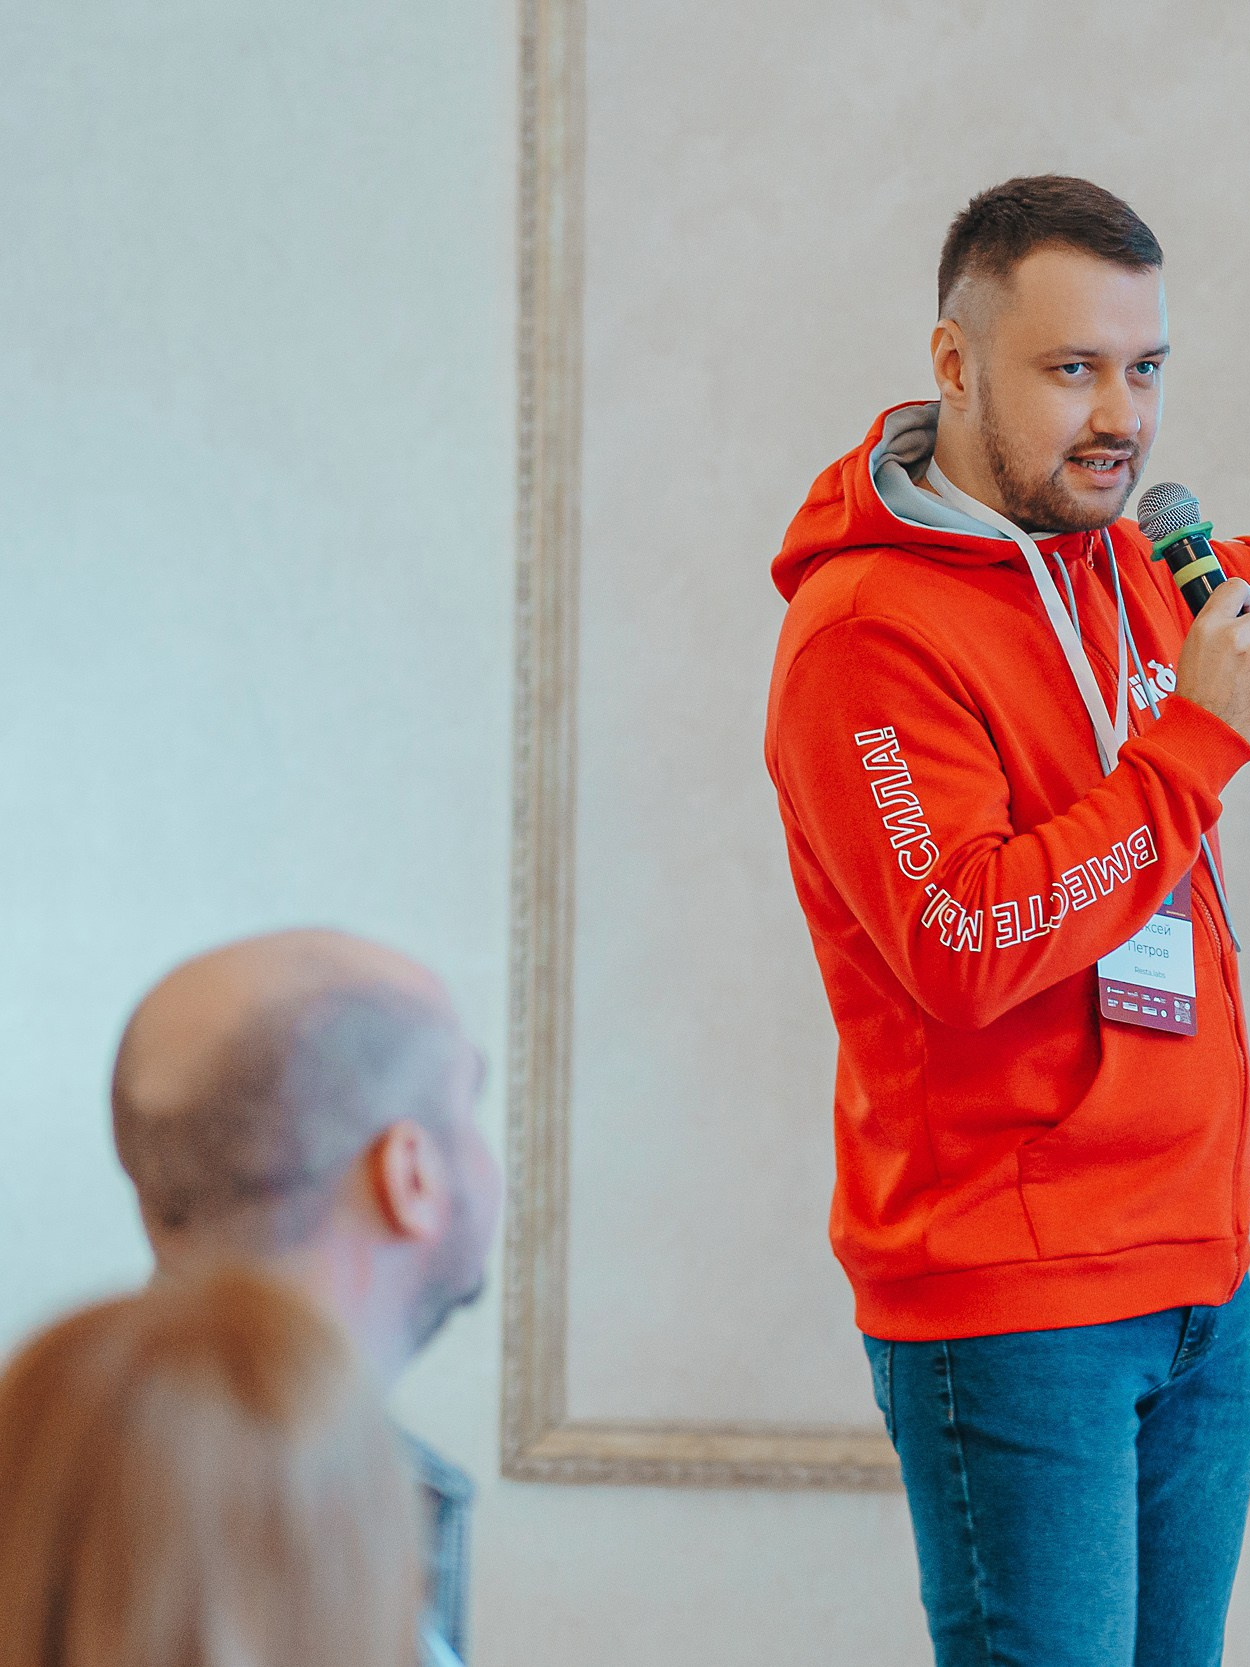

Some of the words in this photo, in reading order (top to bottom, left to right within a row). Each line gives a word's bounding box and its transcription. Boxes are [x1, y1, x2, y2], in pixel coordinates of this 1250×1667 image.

[854, 726, 940, 880] СИЛА!
[991, 824, 1158, 949] ВМЕСТЕ
[1127, 939, 1170, 959] Петров
[1143, 922, 1172, 936] ксей
